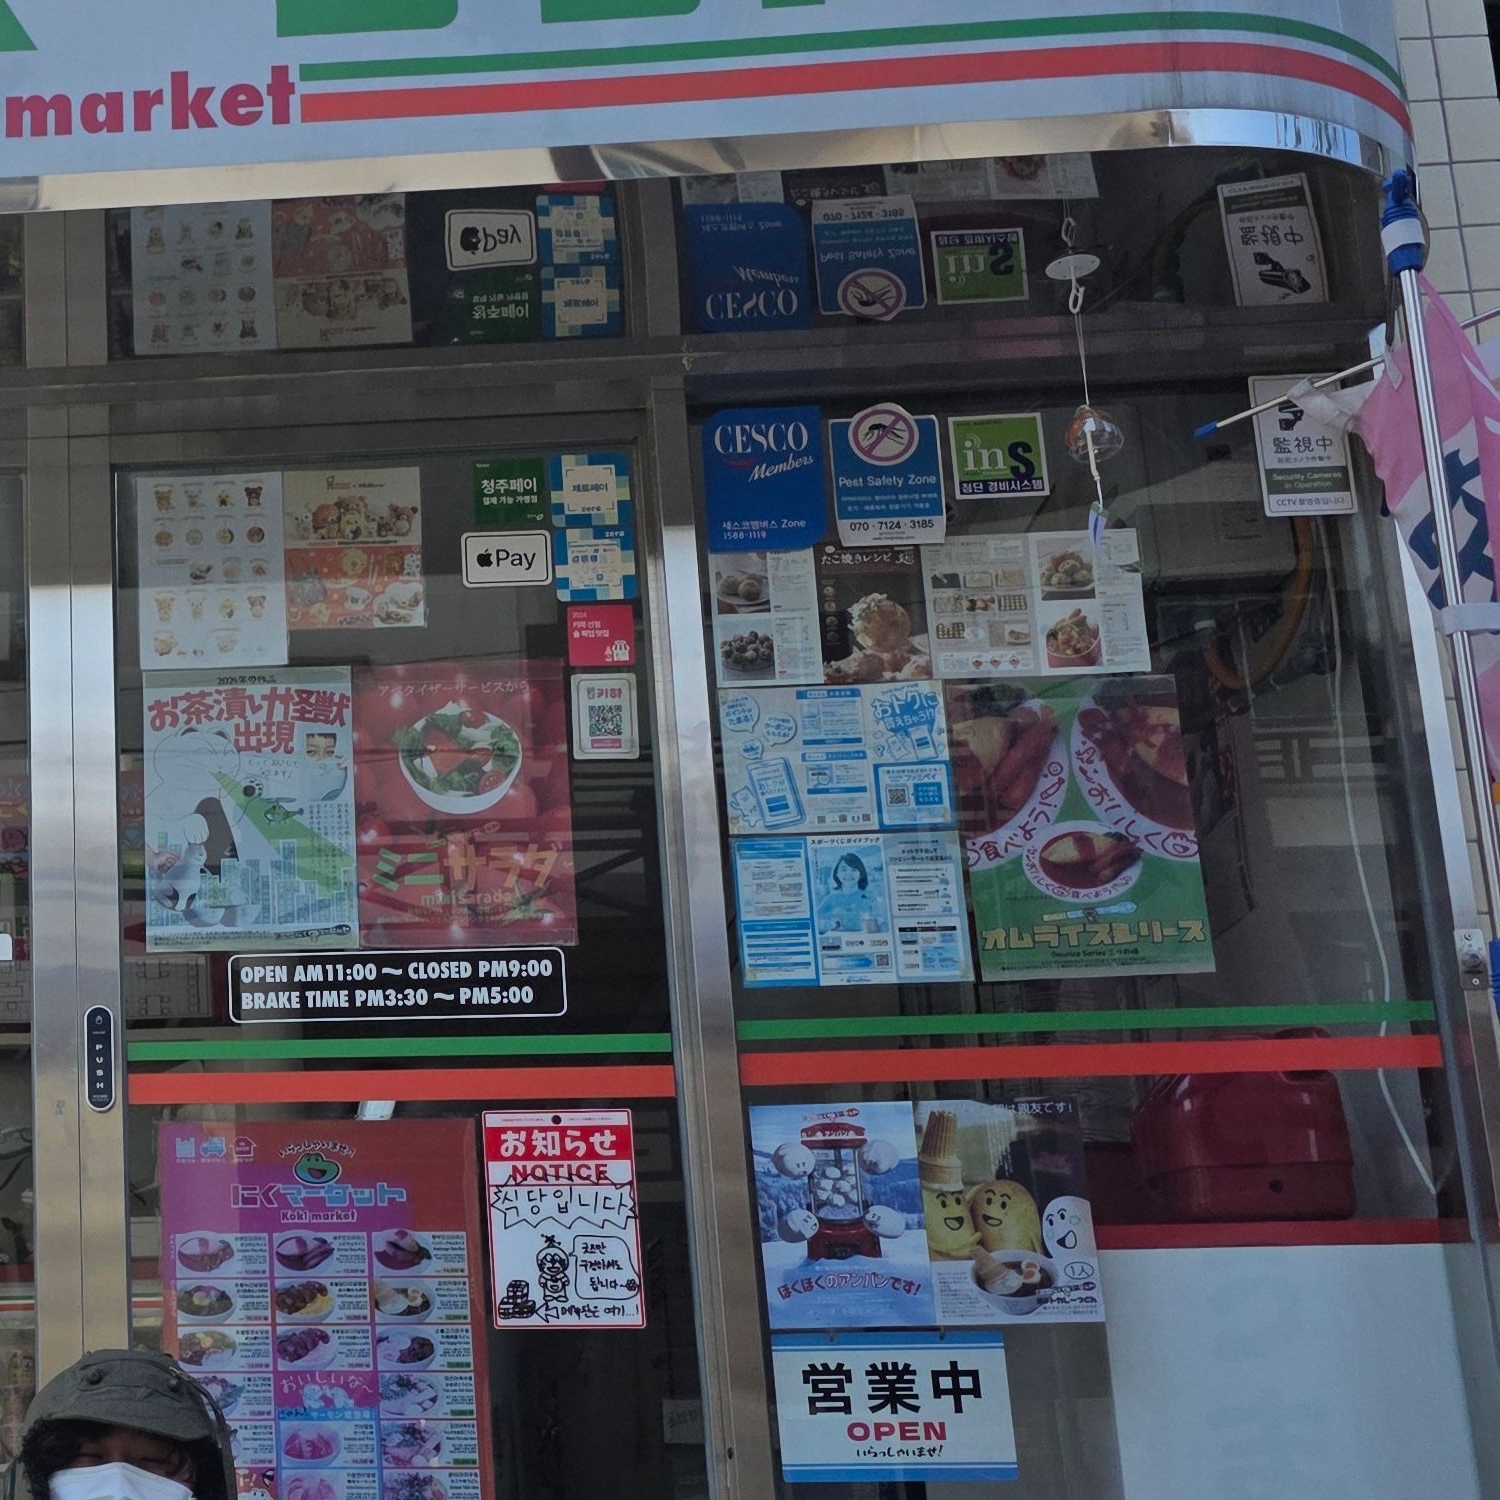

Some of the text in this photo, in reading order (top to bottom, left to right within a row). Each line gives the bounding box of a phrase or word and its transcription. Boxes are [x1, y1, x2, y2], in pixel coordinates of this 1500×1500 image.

[5, 66, 296, 138] market
[713, 421, 809, 455] CESCO
[1272, 435, 1334, 454] 監視中
[748, 453, 814, 482] Members
[1272, 471, 1342, 481] Security Cameras
[481, 477, 538, 495] 청주페이
[838, 472, 937, 488] Pest Safety Zone
[961, 479, 1044, 494] 첨단 경비시스템
[1294, 480, 1333, 489] Operation
[1276, 498, 1297, 507] CCTV
[781, 518, 807, 529] Zone
[849, 519, 935, 532] 070 7124 3185
[496, 549, 537, 571] Pay
[233, 720, 296, 755] 出現
[241, 959, 553, 985] OPEN AM11:00 CLOSED PM9:00
[240, 985, 534, 1011] BRAKE TIME PM3:30 PM5:00
[499, 1129, 617, 1158] お知らせ
[511, 1163, 609, 1182] NOTICE
[230, 1182, 407, 1208] にくマーケット
[501, 1186, 628, 1217] 식당입니다
[280, 1208, 358, 1223] Koki market
[801, 1360, 983, 1416] 営業中
[846, 1420, 948, 1442] OPEN
[855, 1445, 944, 1459] いらっしゃいませ!
